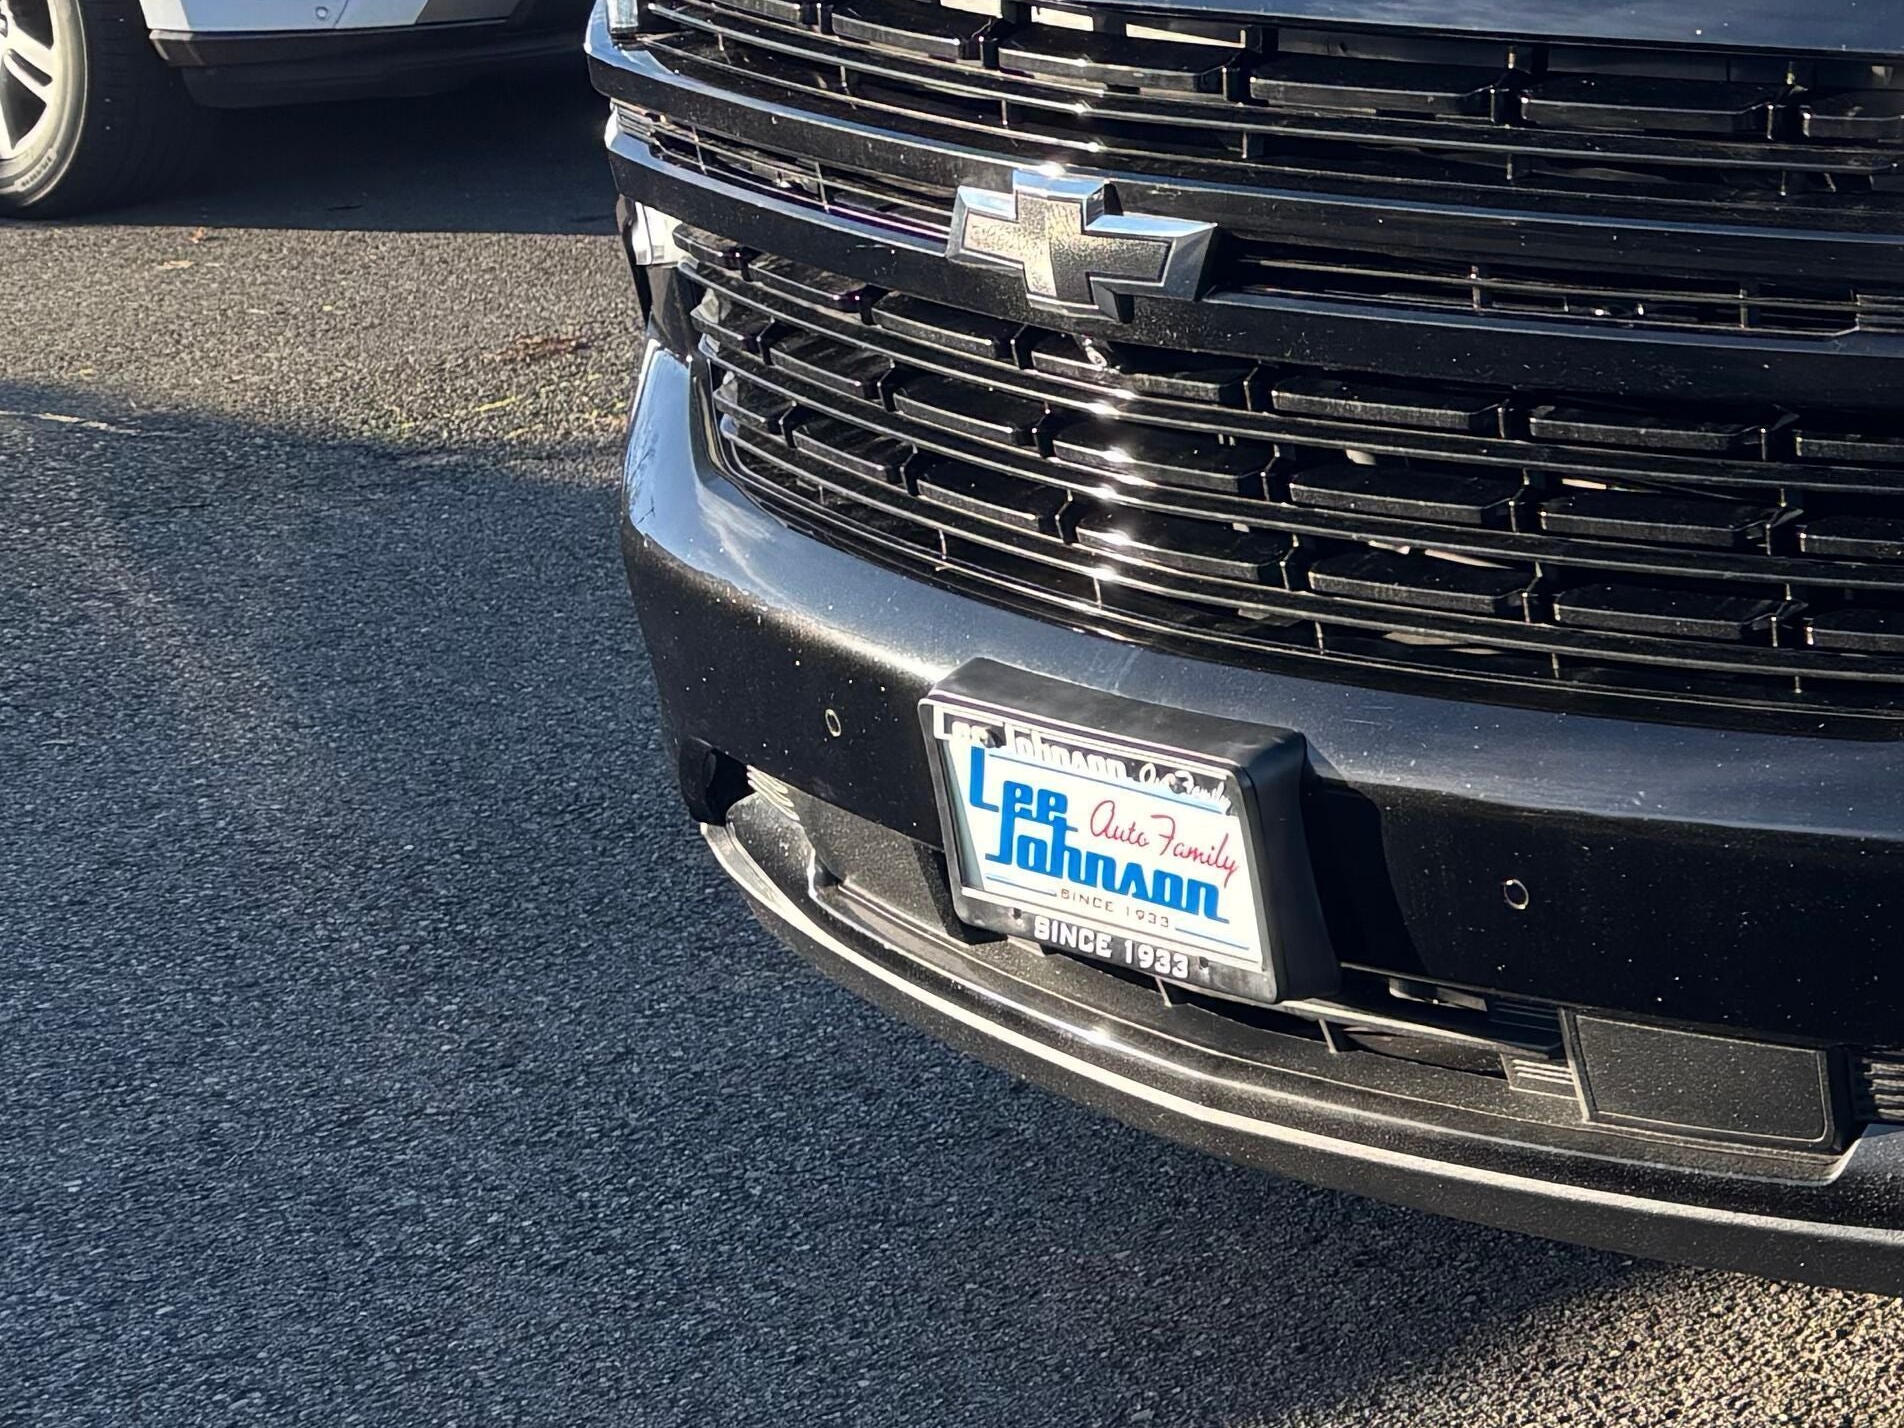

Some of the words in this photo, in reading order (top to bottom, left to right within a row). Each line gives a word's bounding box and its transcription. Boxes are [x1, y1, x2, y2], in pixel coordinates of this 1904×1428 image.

[969, 746, 1078, 832] Lee
[985, 808, 1230, 924] Johnson
[1089, 799, 1150, 848] Auto
[1150, 813, 1239, 889] Family
[1034, 915, 1113, 959] SINCE
[1124, 938, 1190, 980] 1933
[1060, 888, 1115, 913] SINCE
[1125, 905, 1170, 929] 1933
